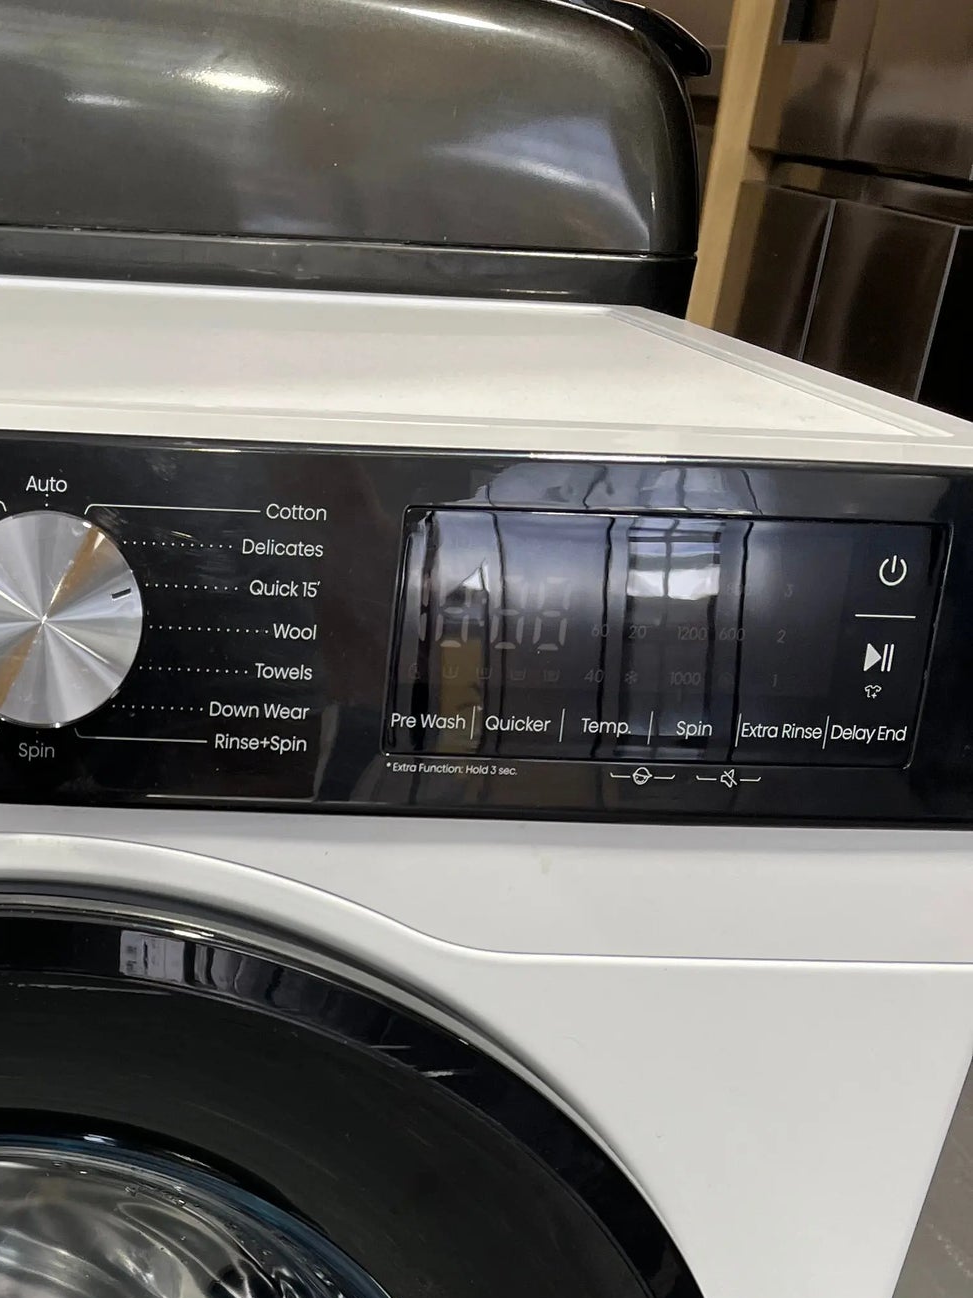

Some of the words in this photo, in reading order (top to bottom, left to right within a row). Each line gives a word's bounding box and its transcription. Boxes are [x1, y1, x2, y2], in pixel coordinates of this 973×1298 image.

[25, 475, 68, 493] Auto
[265, 503, 327, 521] Cotton
[241, 538, 324, 557] Delicates
[249, 579, 299, 598] Quick
[273, 623, 317, 641] Wool
[628, 624, 648, 640] 20
[676, 625, 708, 642] 1200
[254, 662, 313, 680] Towels
[584, 669, 605, 684] 40
[670, 671, 702, 687] 1000
[209, 701, 260, 719] Down
[263, 703, 310, 720] Wear
[390, 713, 417, 729] Pre
[420, 714, 466, 730] Wash
[484, 715, 552, 732] Quicker
[580, 718, 632, 738] Temp.
[676, 720, 713, 740] Spin
[741, 722, 779, 739] Extra
[781, 723, 823, 740] Rinse
[830, 724, 877, 745] Delay
[877, 725, 908, 742] End
[18, 741, 56, 759] Spin
[214, 733, 308, 755] Rinse+Spin
[418, 763, 464, 774] Function:
[465, 763, 489, 775] Hold
[490, 765, 497, 775] 3
[498, 767, 518, 776] sec.
